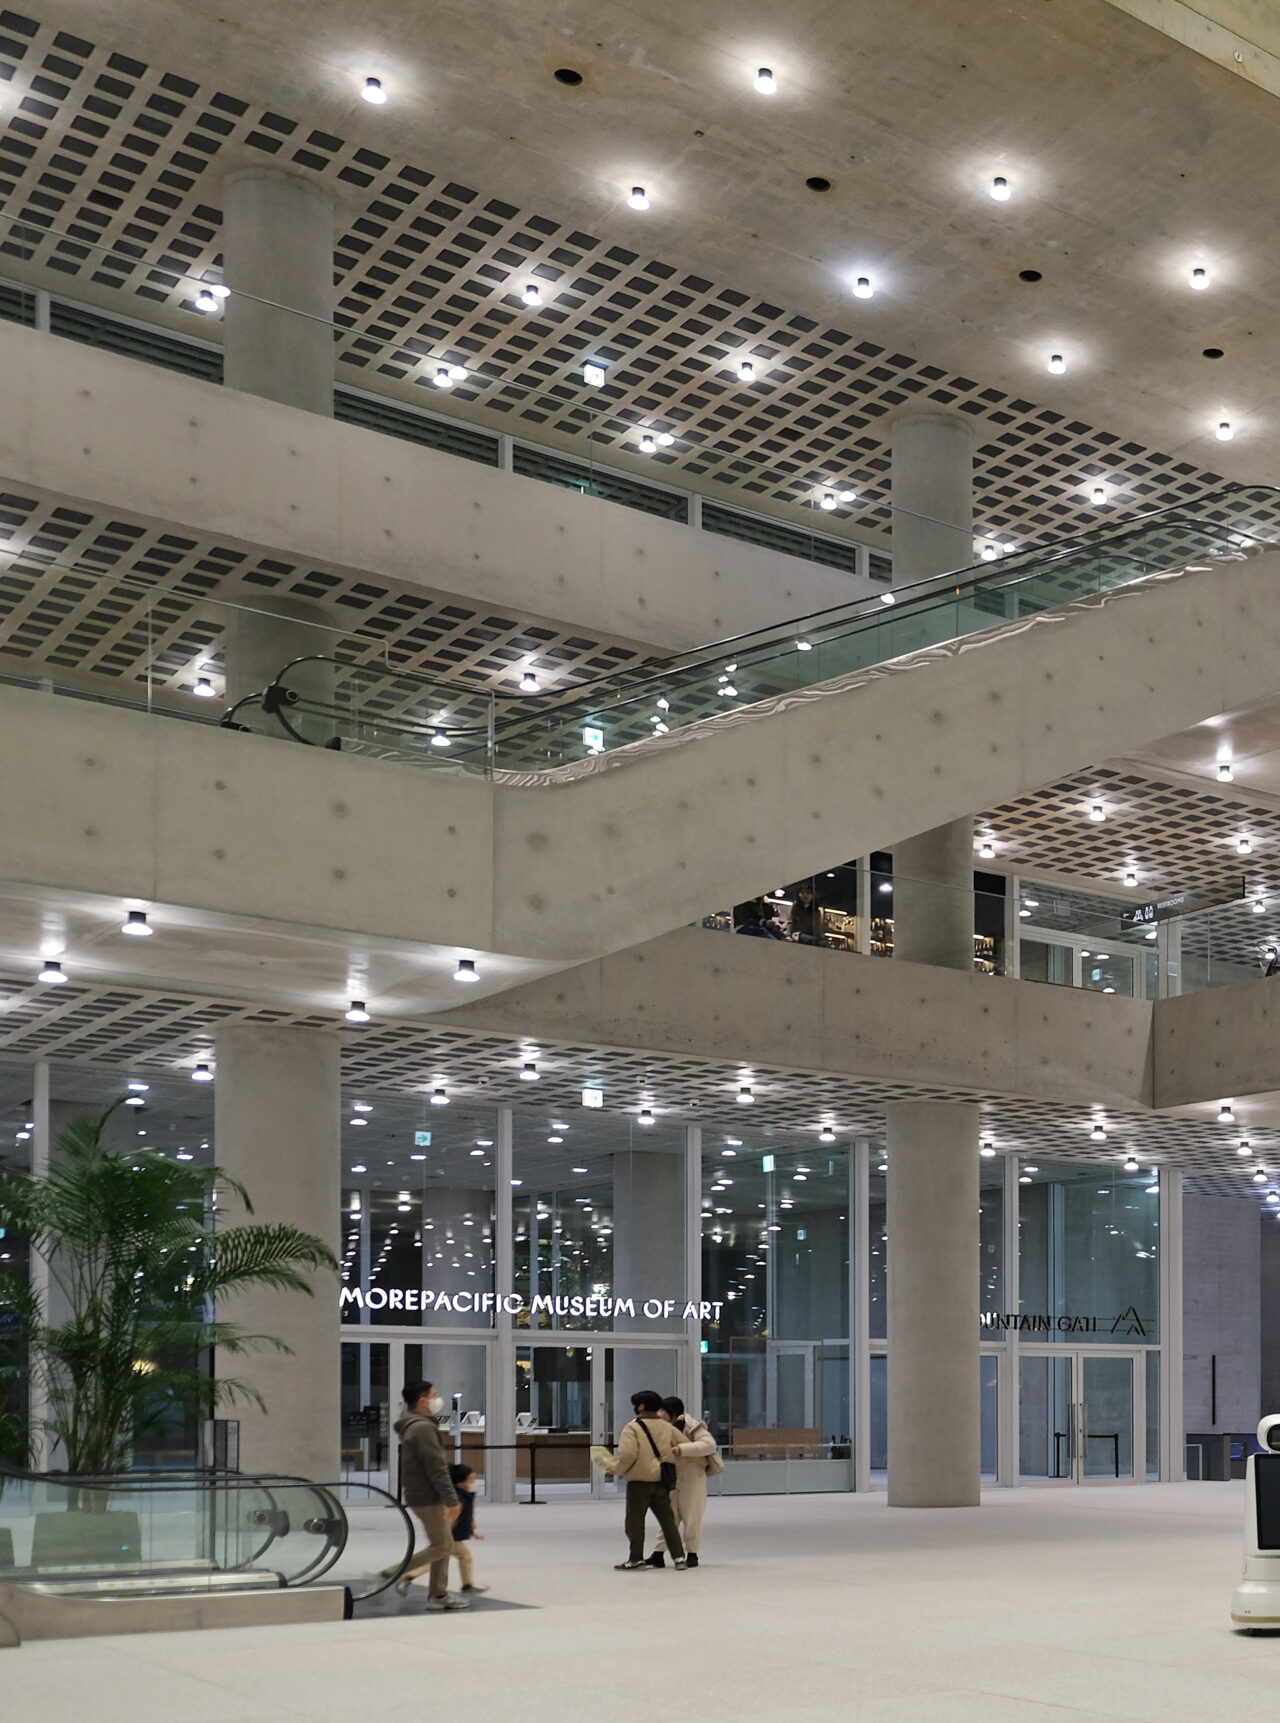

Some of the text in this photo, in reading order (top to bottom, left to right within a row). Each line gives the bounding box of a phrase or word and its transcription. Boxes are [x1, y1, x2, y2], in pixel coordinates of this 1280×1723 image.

[338, 1286, 724, 1320] MOREPACIFIC MUSEUM OF ART
[980, 1311, 1051, 1331] OUNTAIN
